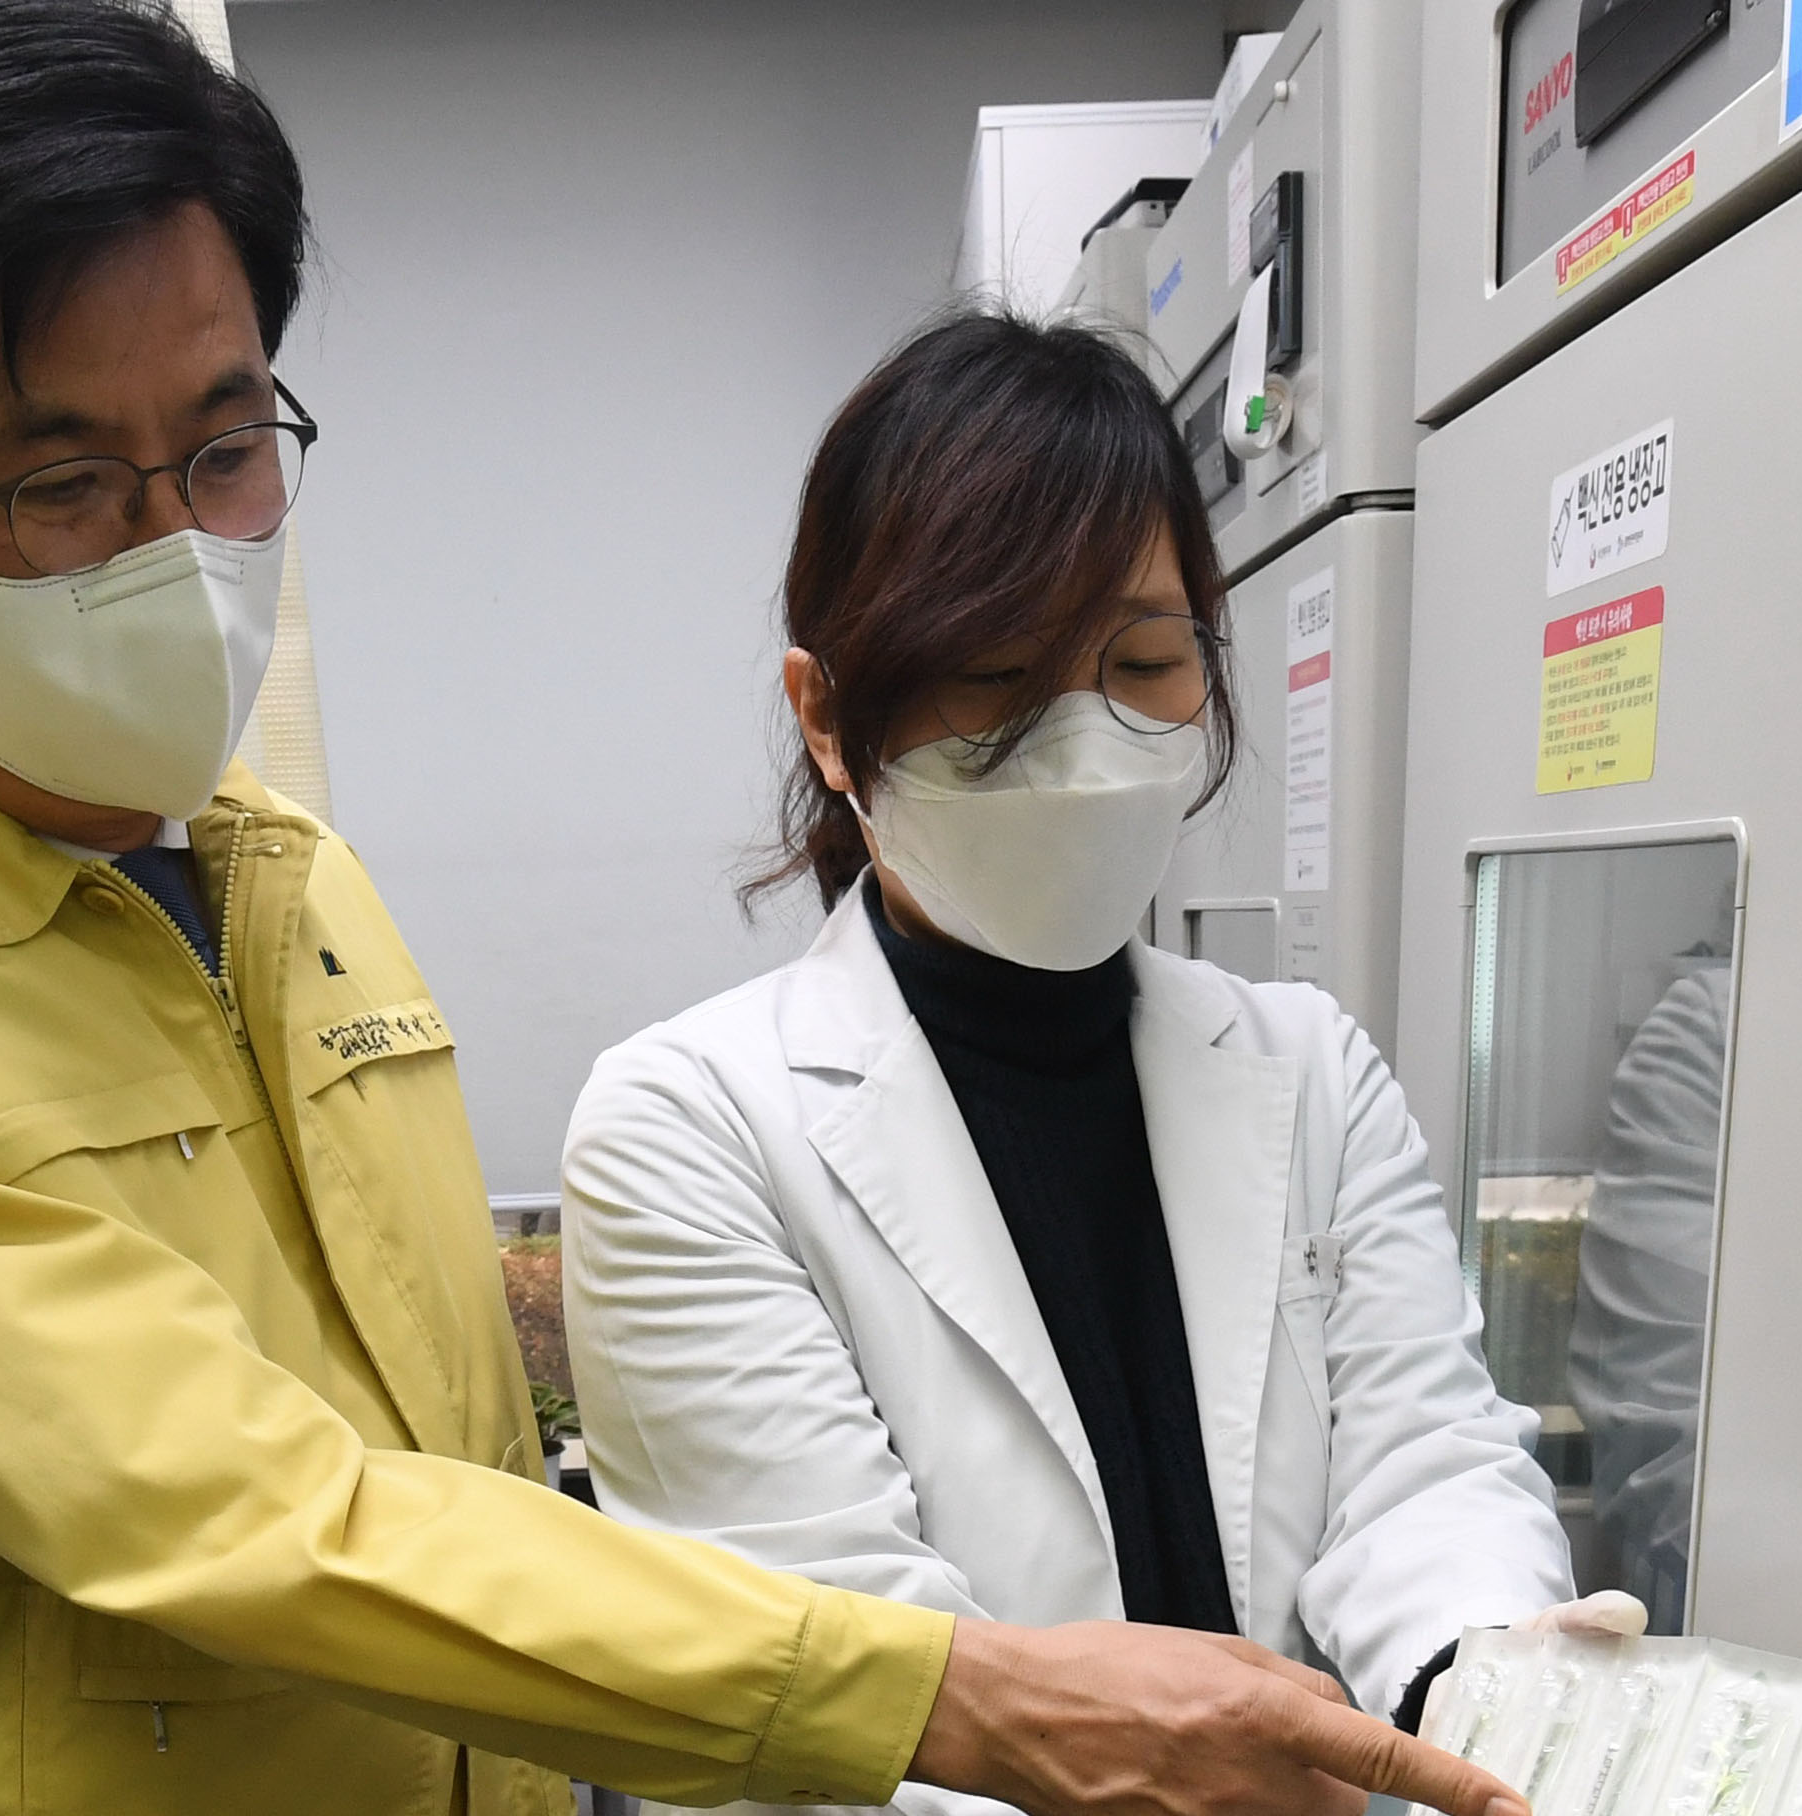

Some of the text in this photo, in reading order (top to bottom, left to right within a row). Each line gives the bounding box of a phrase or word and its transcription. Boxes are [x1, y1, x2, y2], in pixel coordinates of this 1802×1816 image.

[1524, 51, 1573, 135] SANYO
[1578, 433, 1667, 533] 백신 전용 냉장고
